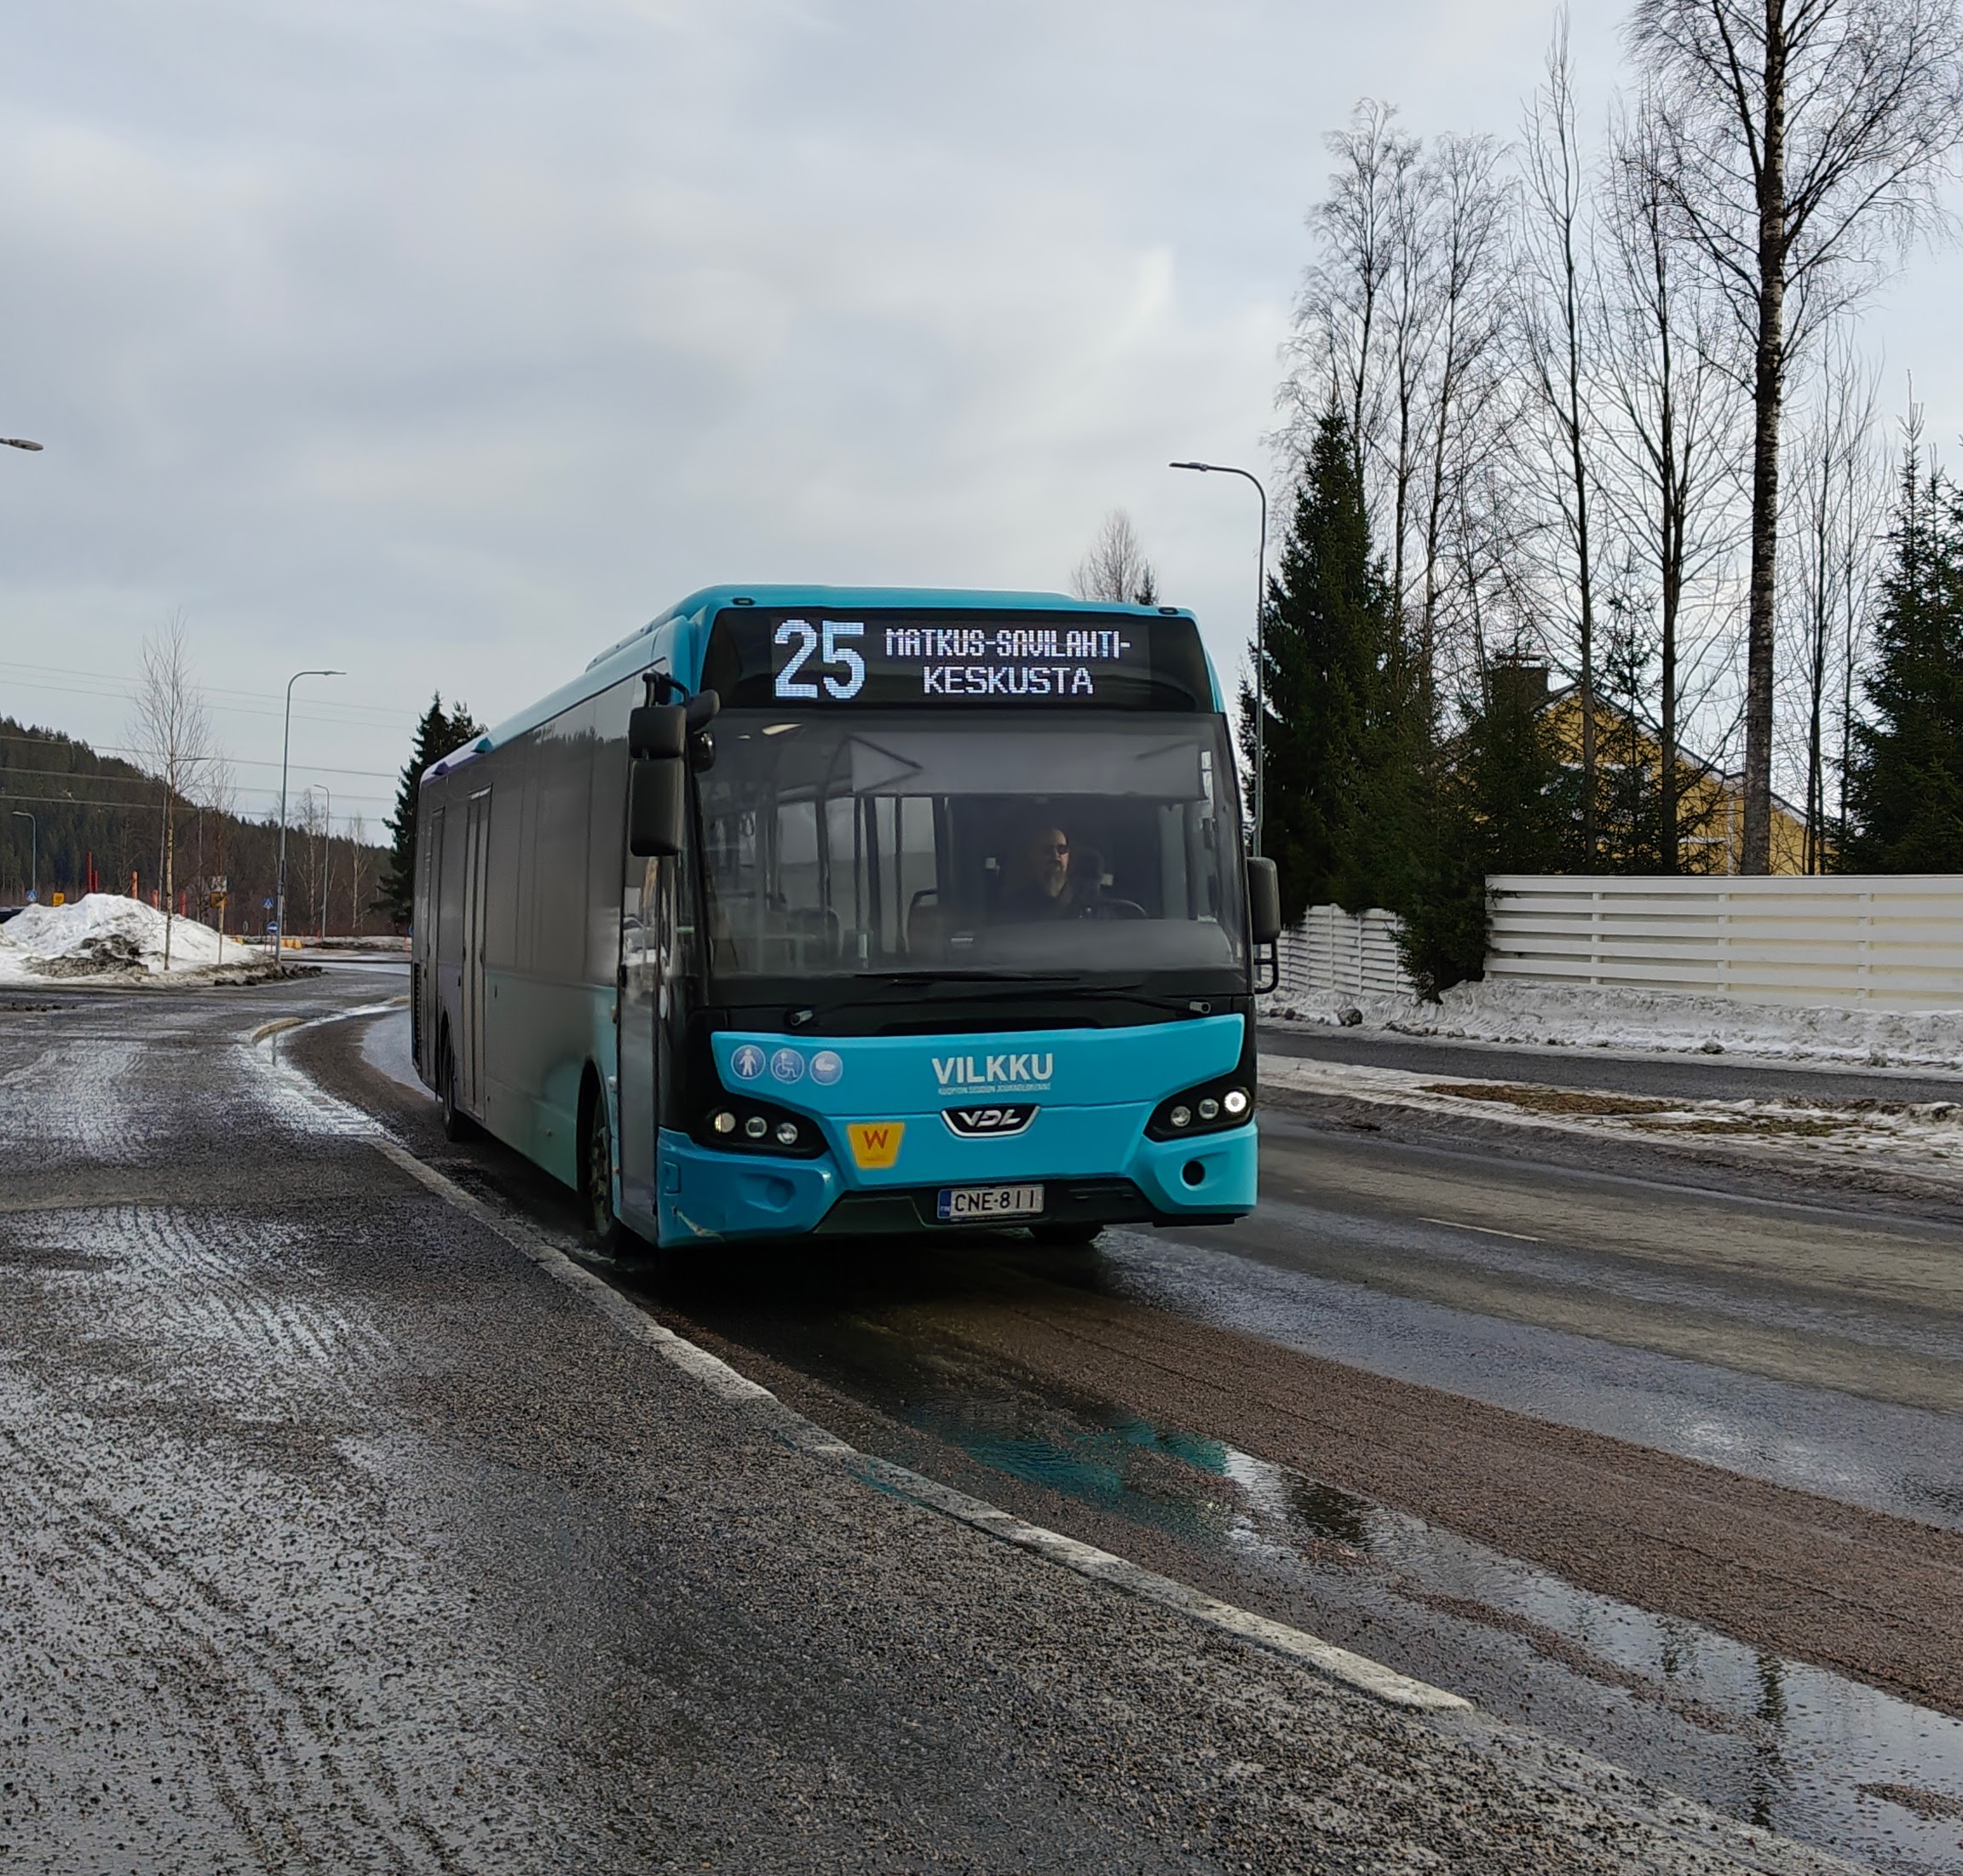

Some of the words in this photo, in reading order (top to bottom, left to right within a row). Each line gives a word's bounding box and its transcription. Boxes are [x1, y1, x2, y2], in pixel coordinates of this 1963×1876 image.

[885, 628, 1131, 658] MATKUS-SAVILAHTI-
[774, 619, 865, 699] 25
[924, 666, 1093, 694] KESKUSTA
[931, 1053, 1053, 1085] VILKKU
[958, 1109, 1021, 1127] VDL
[863, 1129, 889, 1149] W
[954, 1189, 1033, 1211] CNE-811
